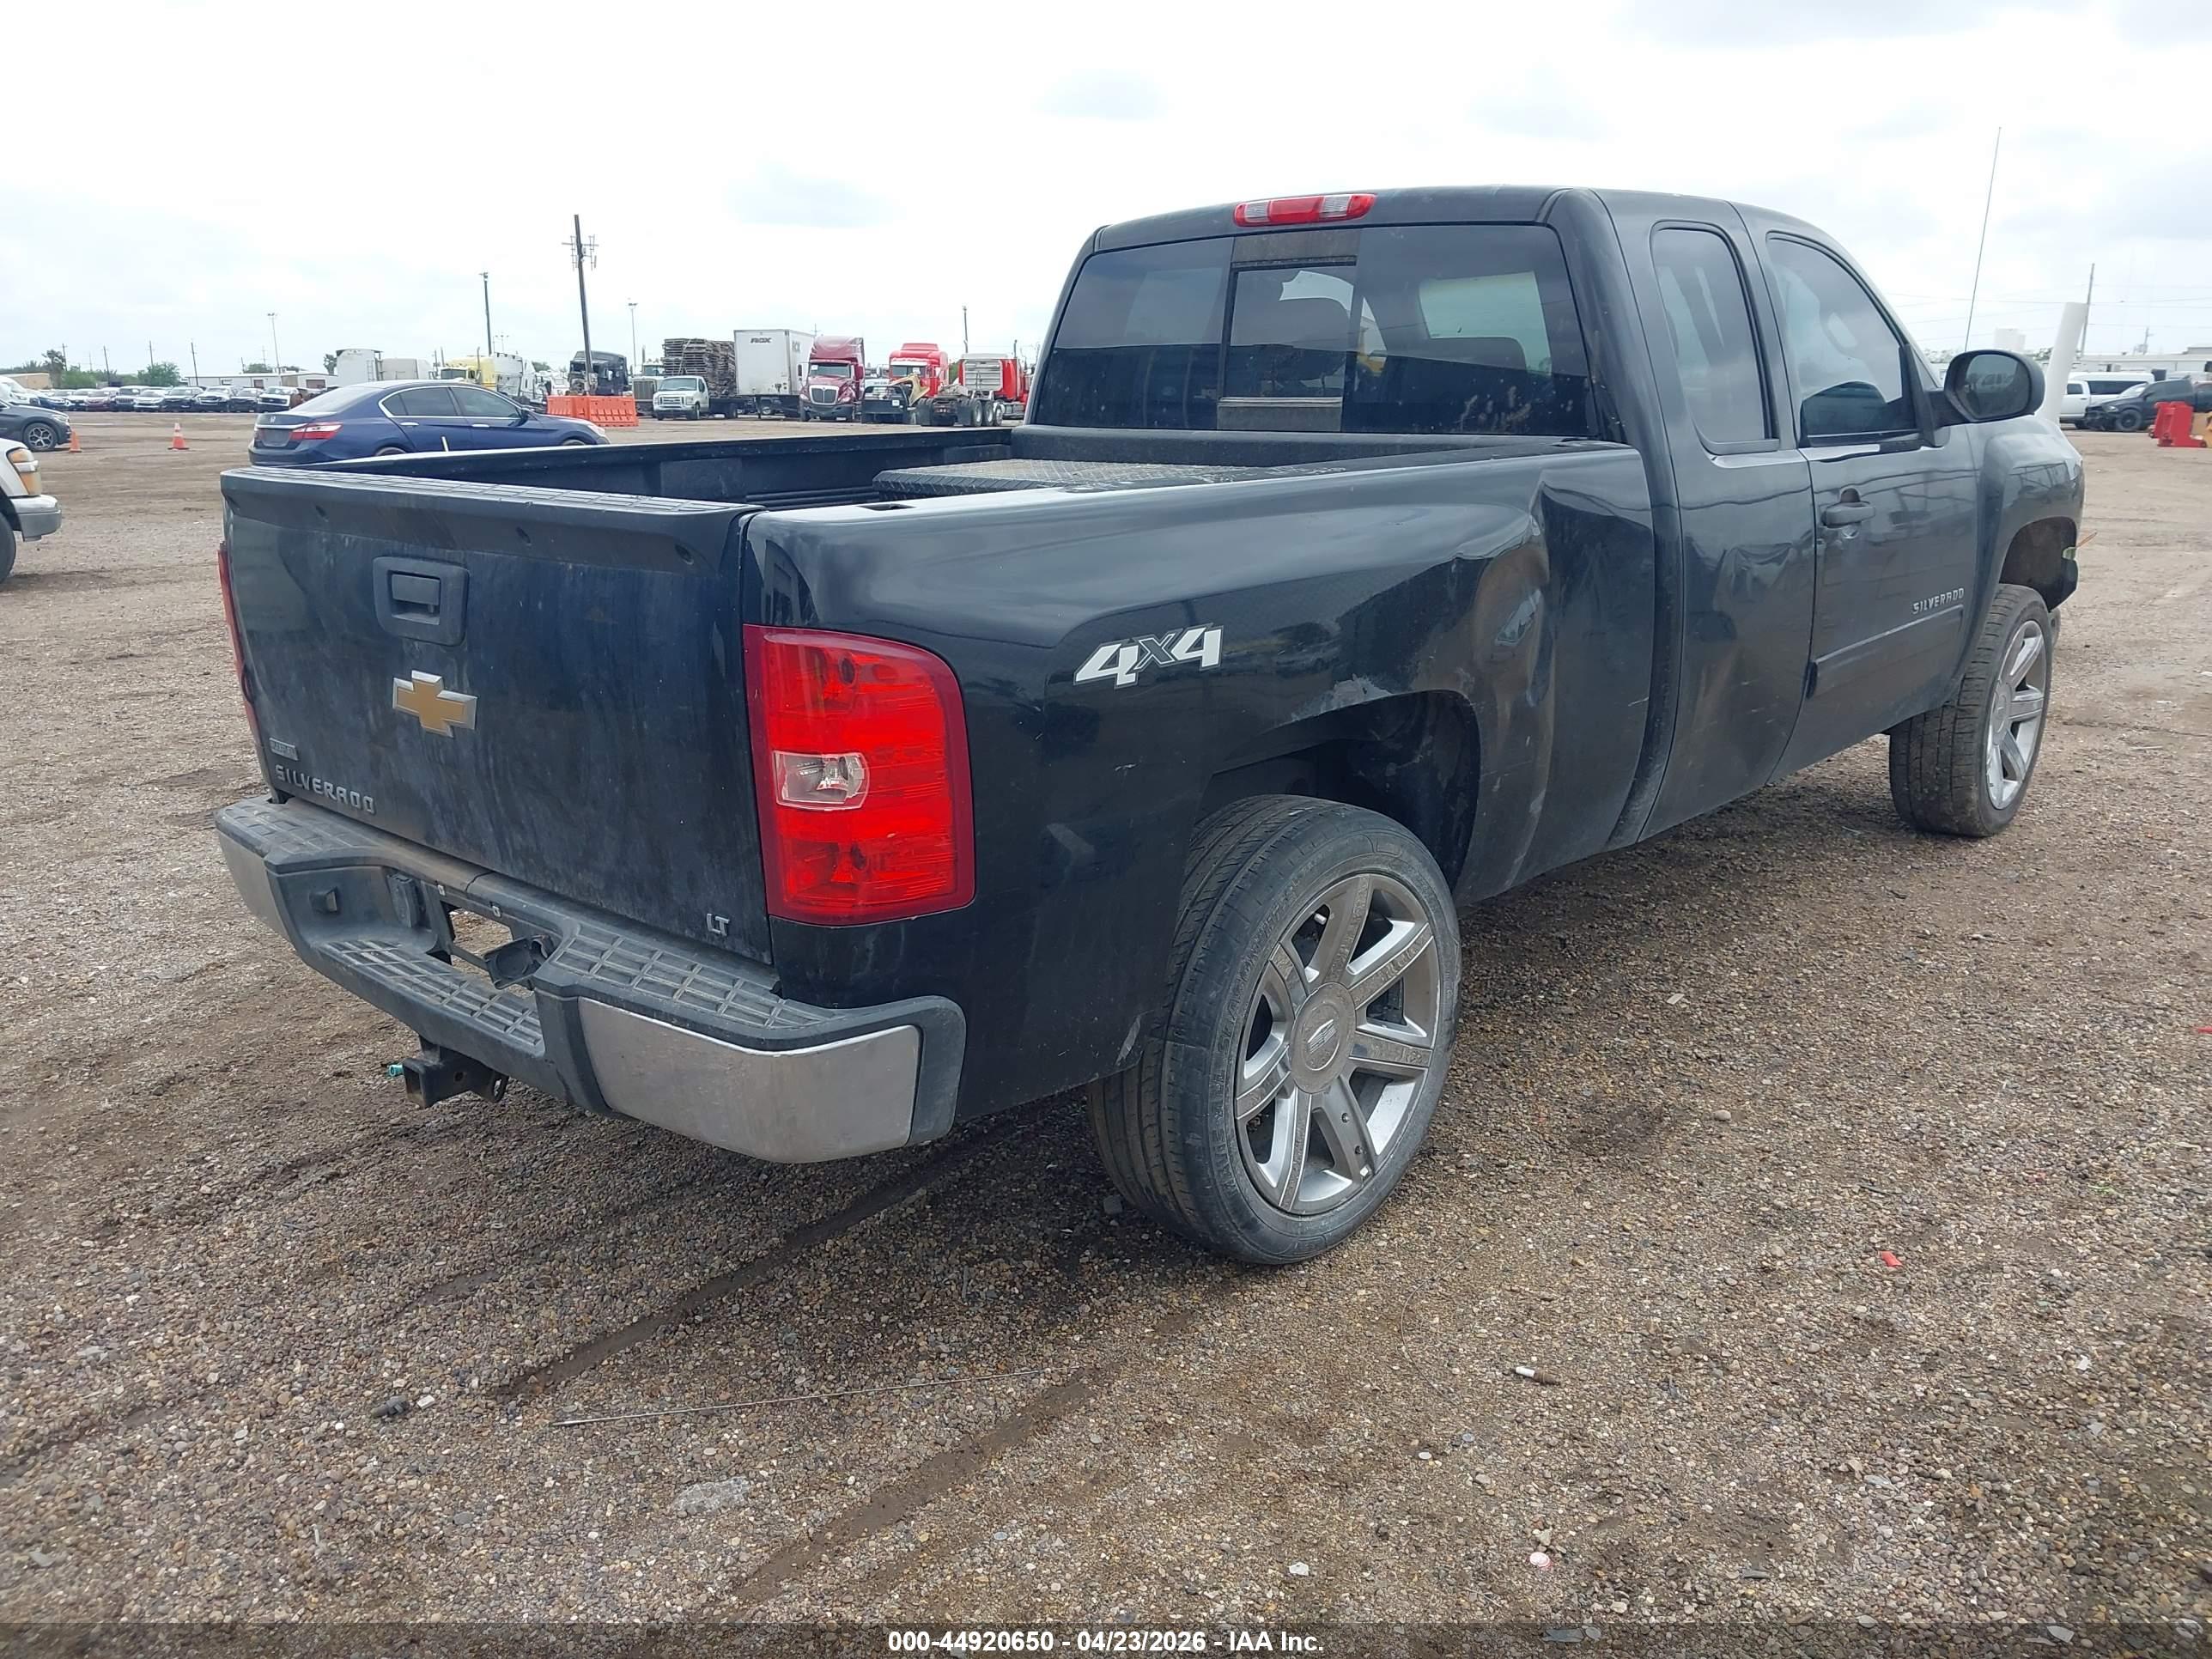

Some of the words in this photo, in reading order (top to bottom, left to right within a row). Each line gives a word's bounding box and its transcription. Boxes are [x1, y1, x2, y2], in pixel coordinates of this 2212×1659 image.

[1912, 587, 1965, 615] SILVERADO
[275, 763, 376, 815] SILVERADO
[706, 913, 730, 936] LT
